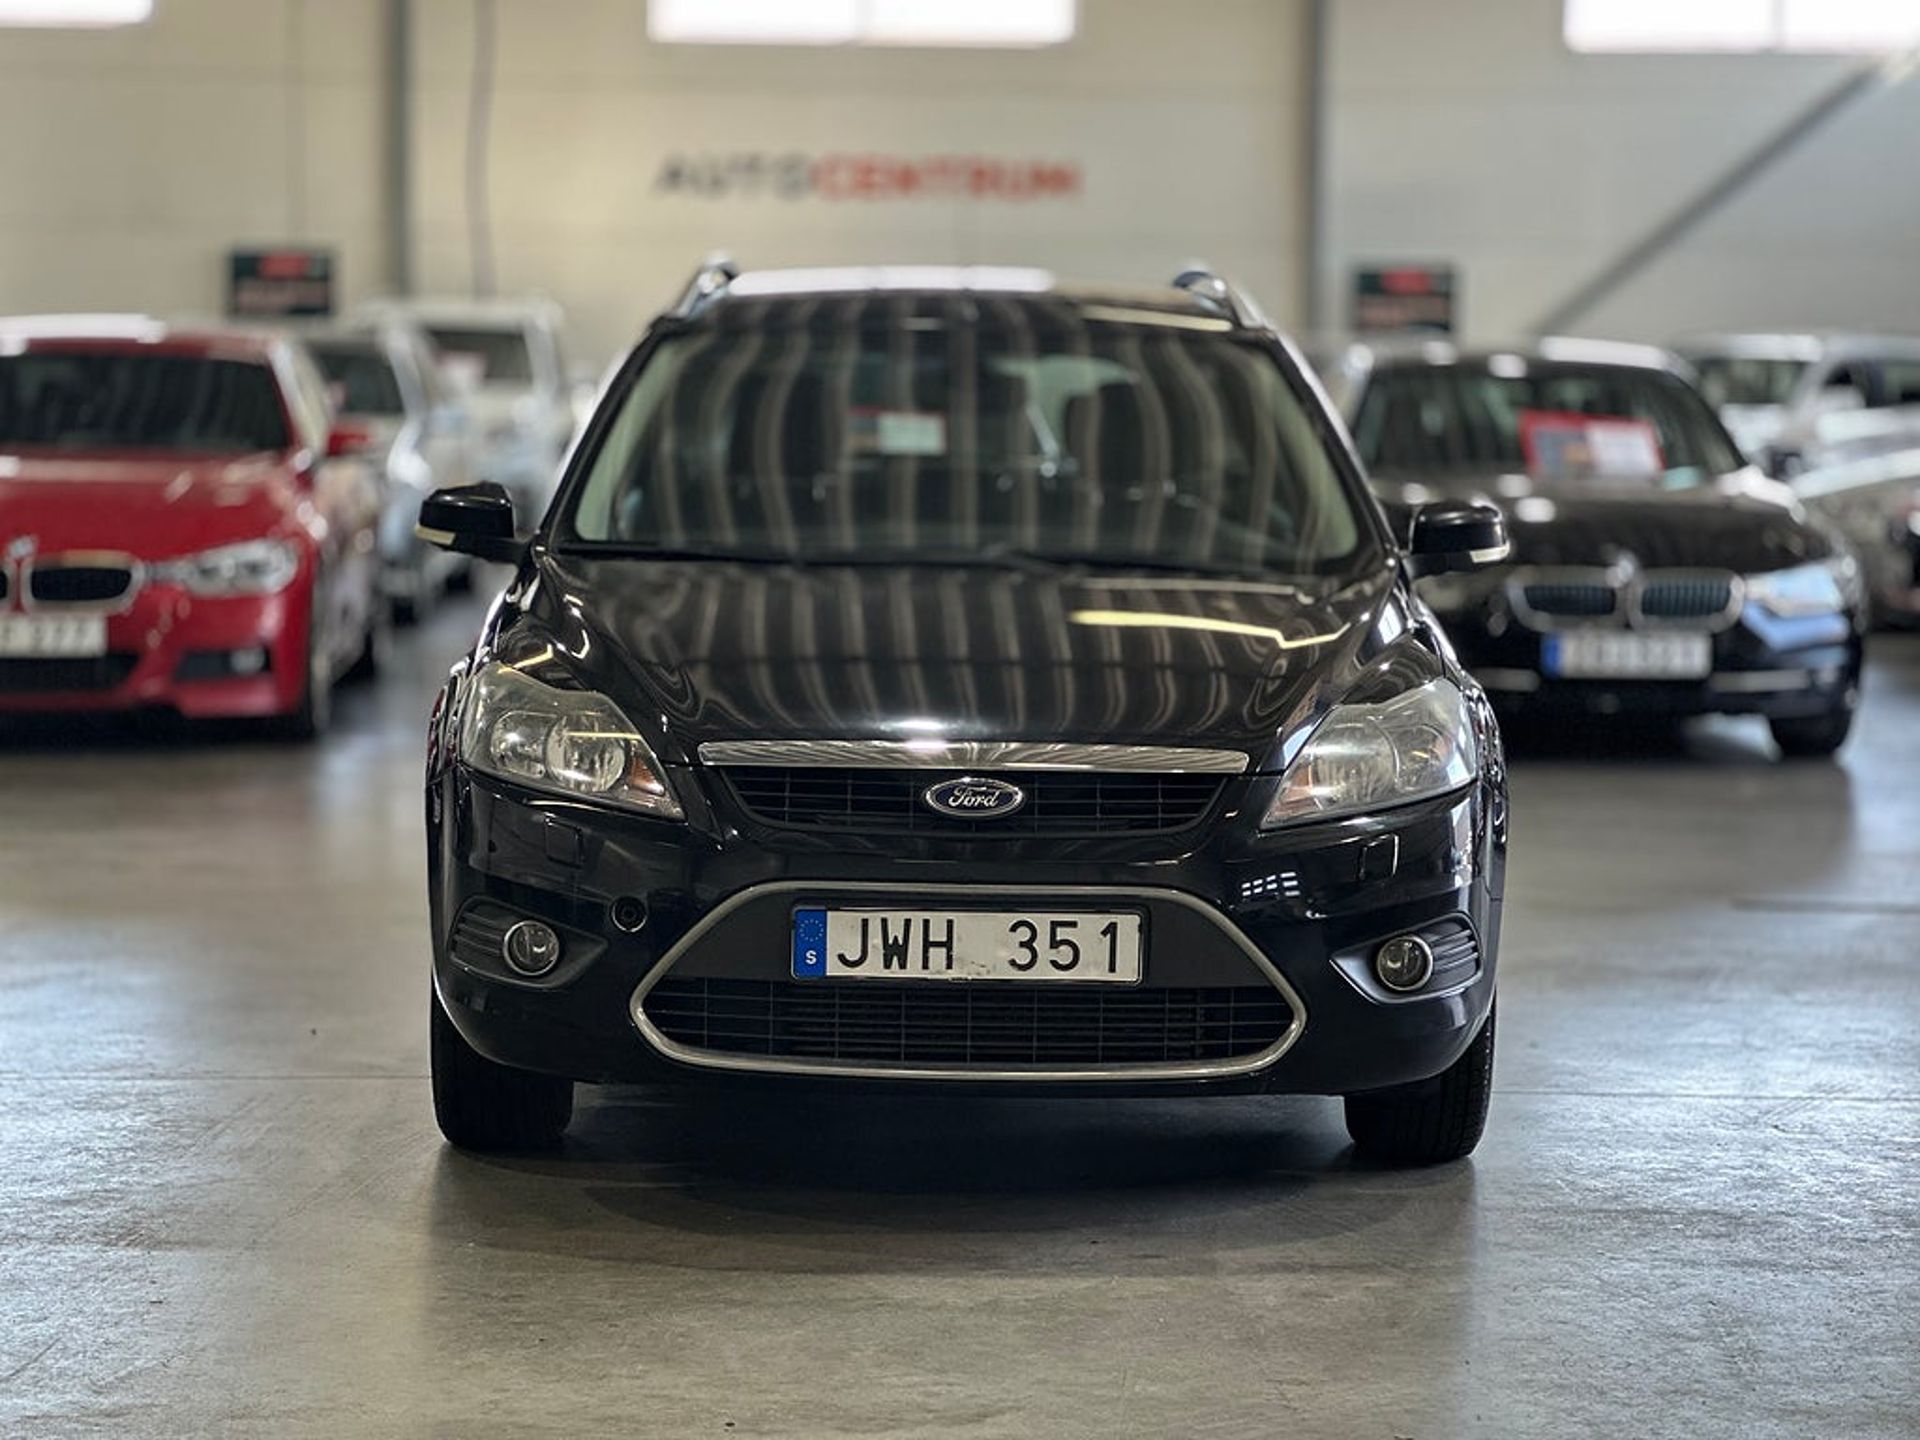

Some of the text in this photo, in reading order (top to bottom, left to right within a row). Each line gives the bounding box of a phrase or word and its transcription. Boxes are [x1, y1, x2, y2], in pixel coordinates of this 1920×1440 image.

[948, 786, 1001, 807] Ford
[837, 917, 1118, 975] JWH 351
[805, 950, 817, 965] S
